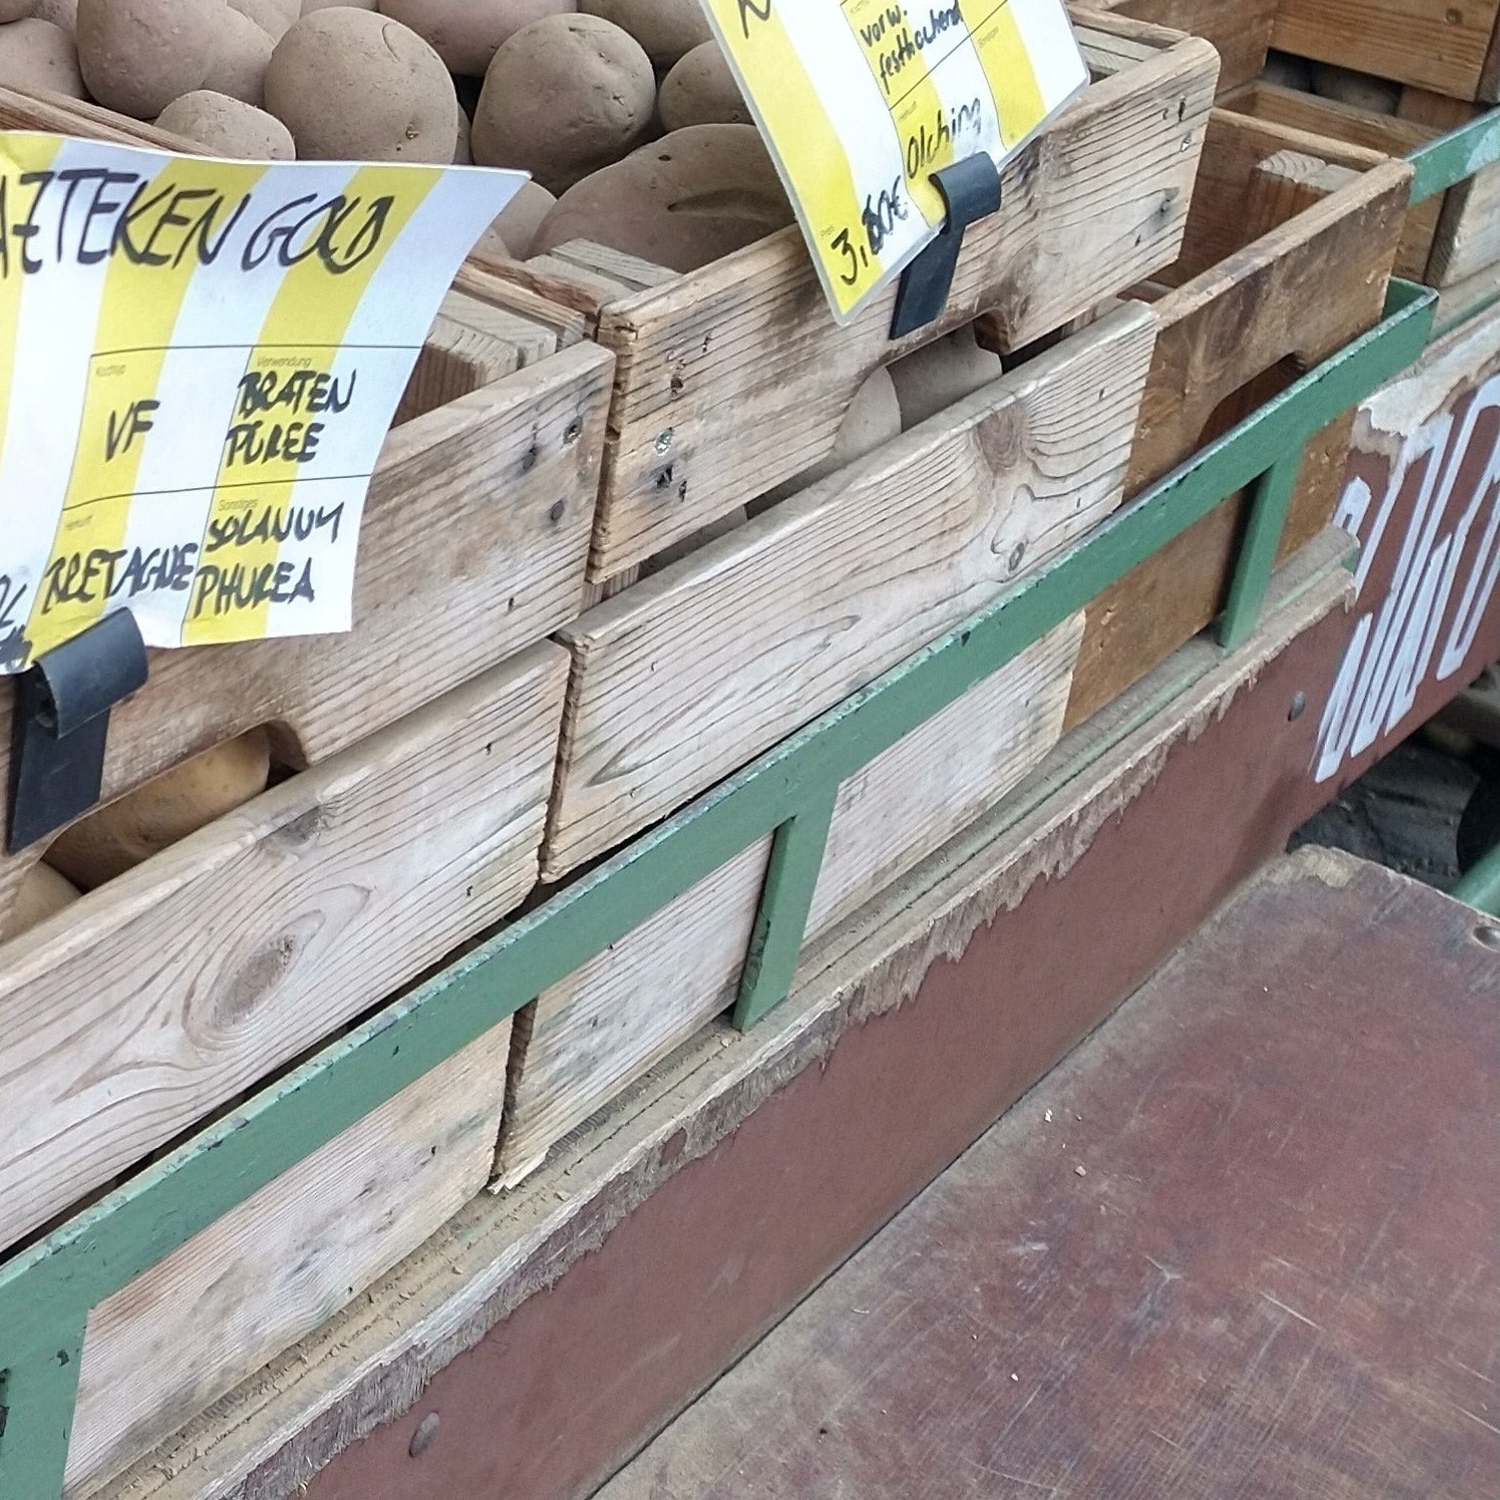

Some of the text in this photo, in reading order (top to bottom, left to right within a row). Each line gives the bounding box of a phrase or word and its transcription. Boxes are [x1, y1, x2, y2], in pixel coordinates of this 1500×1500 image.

[859, 4, 909, 48] vorw.
[240, 192, 397, 276] GOLD
[256, 356, 313, 368] Verwendung
[237, 368, 358, 420] BRATEN
[105, 399, 161, 463] VF
